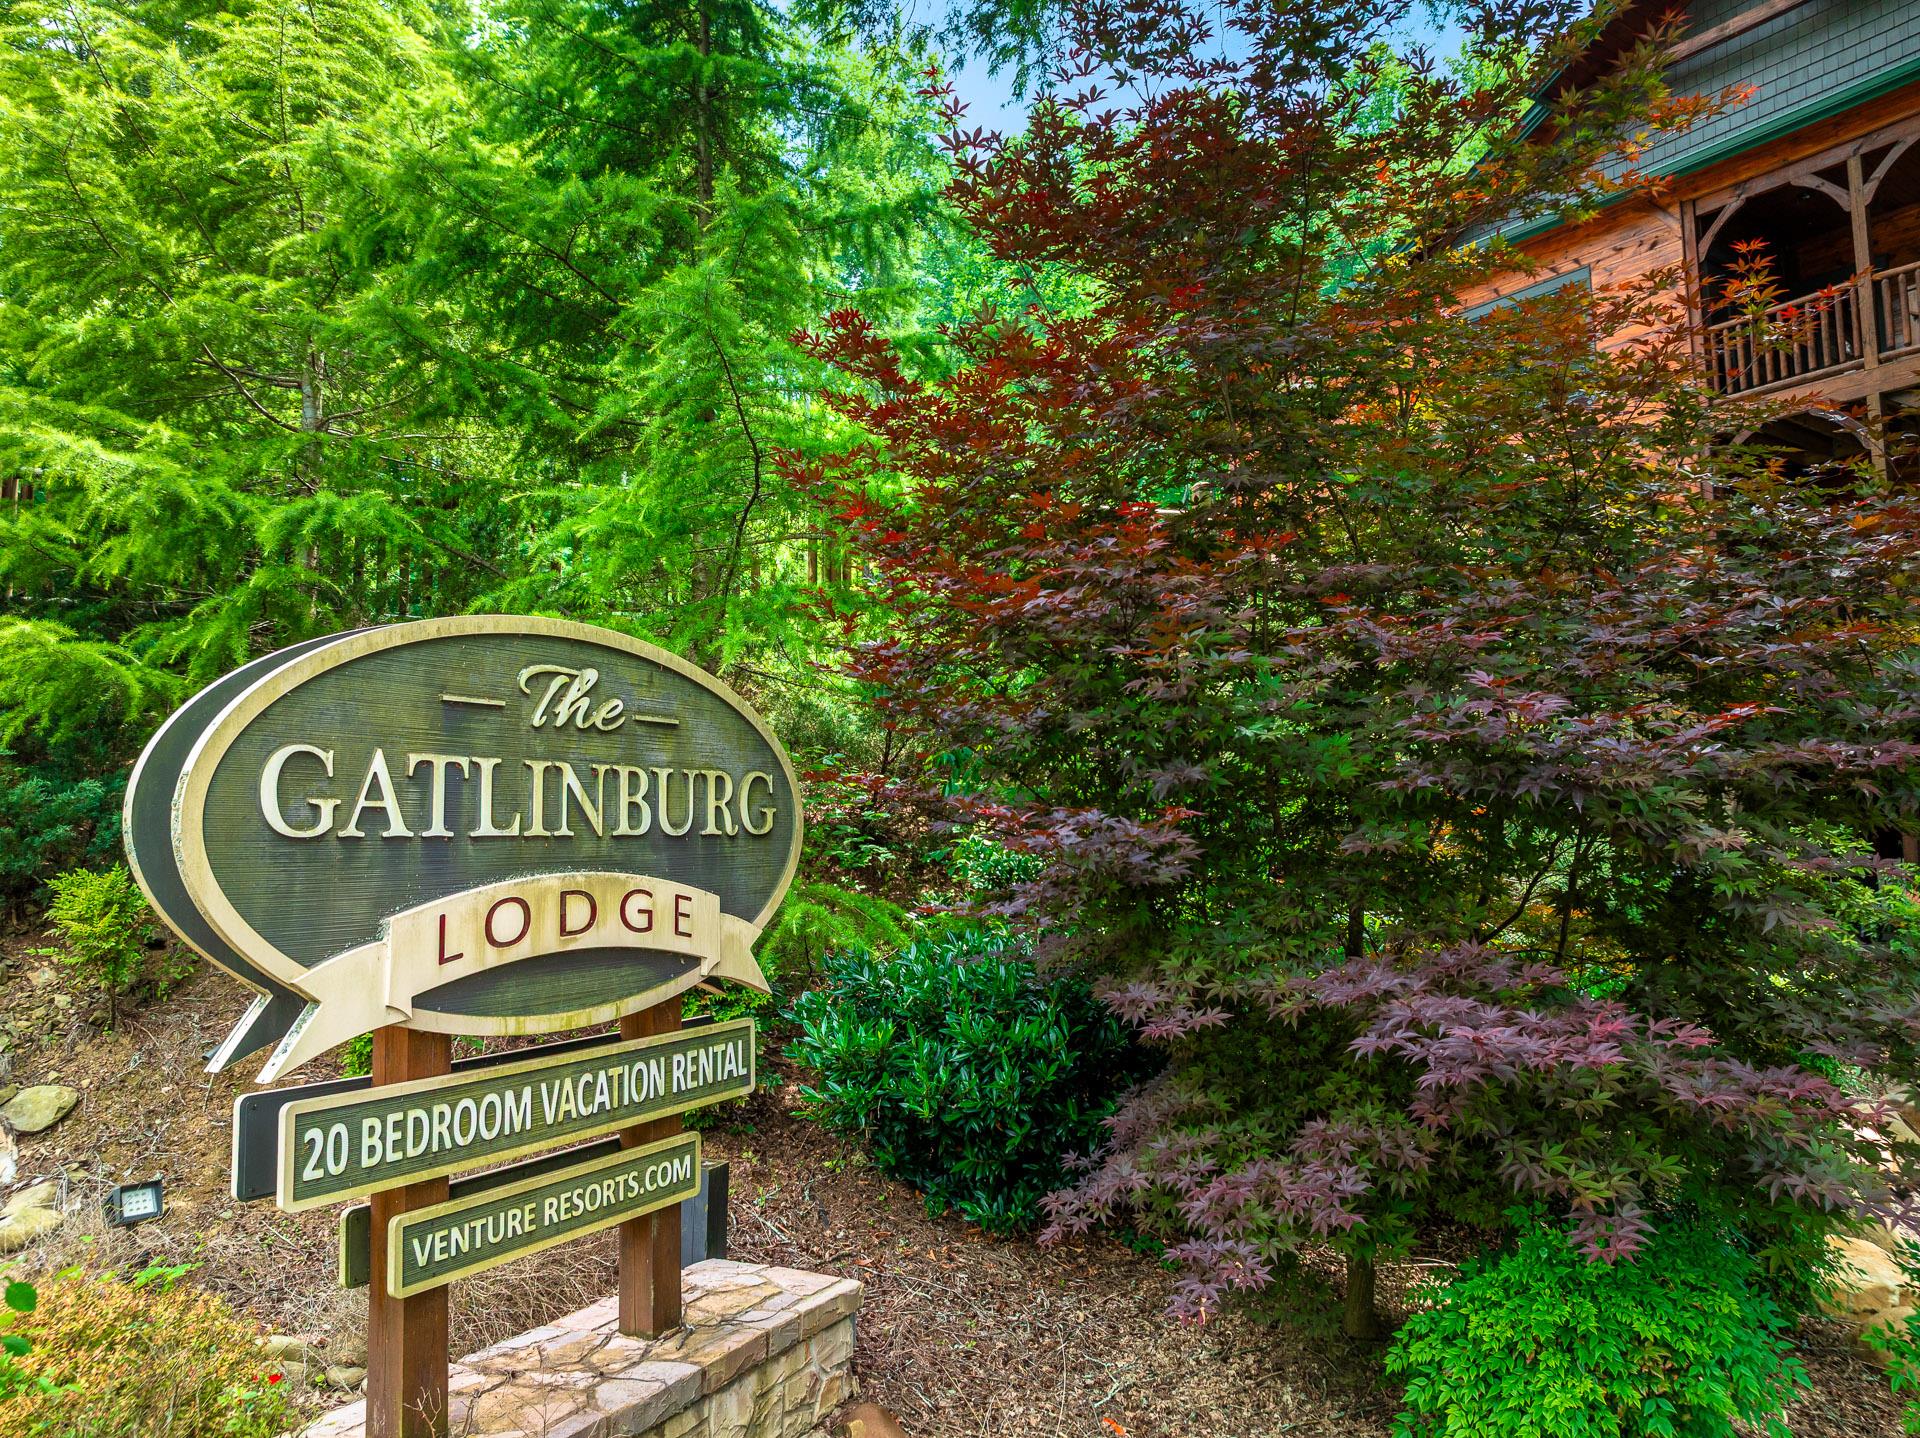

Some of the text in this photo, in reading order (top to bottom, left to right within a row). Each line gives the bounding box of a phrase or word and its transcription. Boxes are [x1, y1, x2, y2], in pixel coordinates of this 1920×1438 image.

[518, 664, 626, 731] The
[259, 744, 778, 839] GATLINBURG
[438, 889, 692, 965] LODGE
[302, 1042, 748, 1182] 20 BEDROOM VACATION RENTAL
[412, 1155, 692, 1267] VENTURE RESORTS.COM
